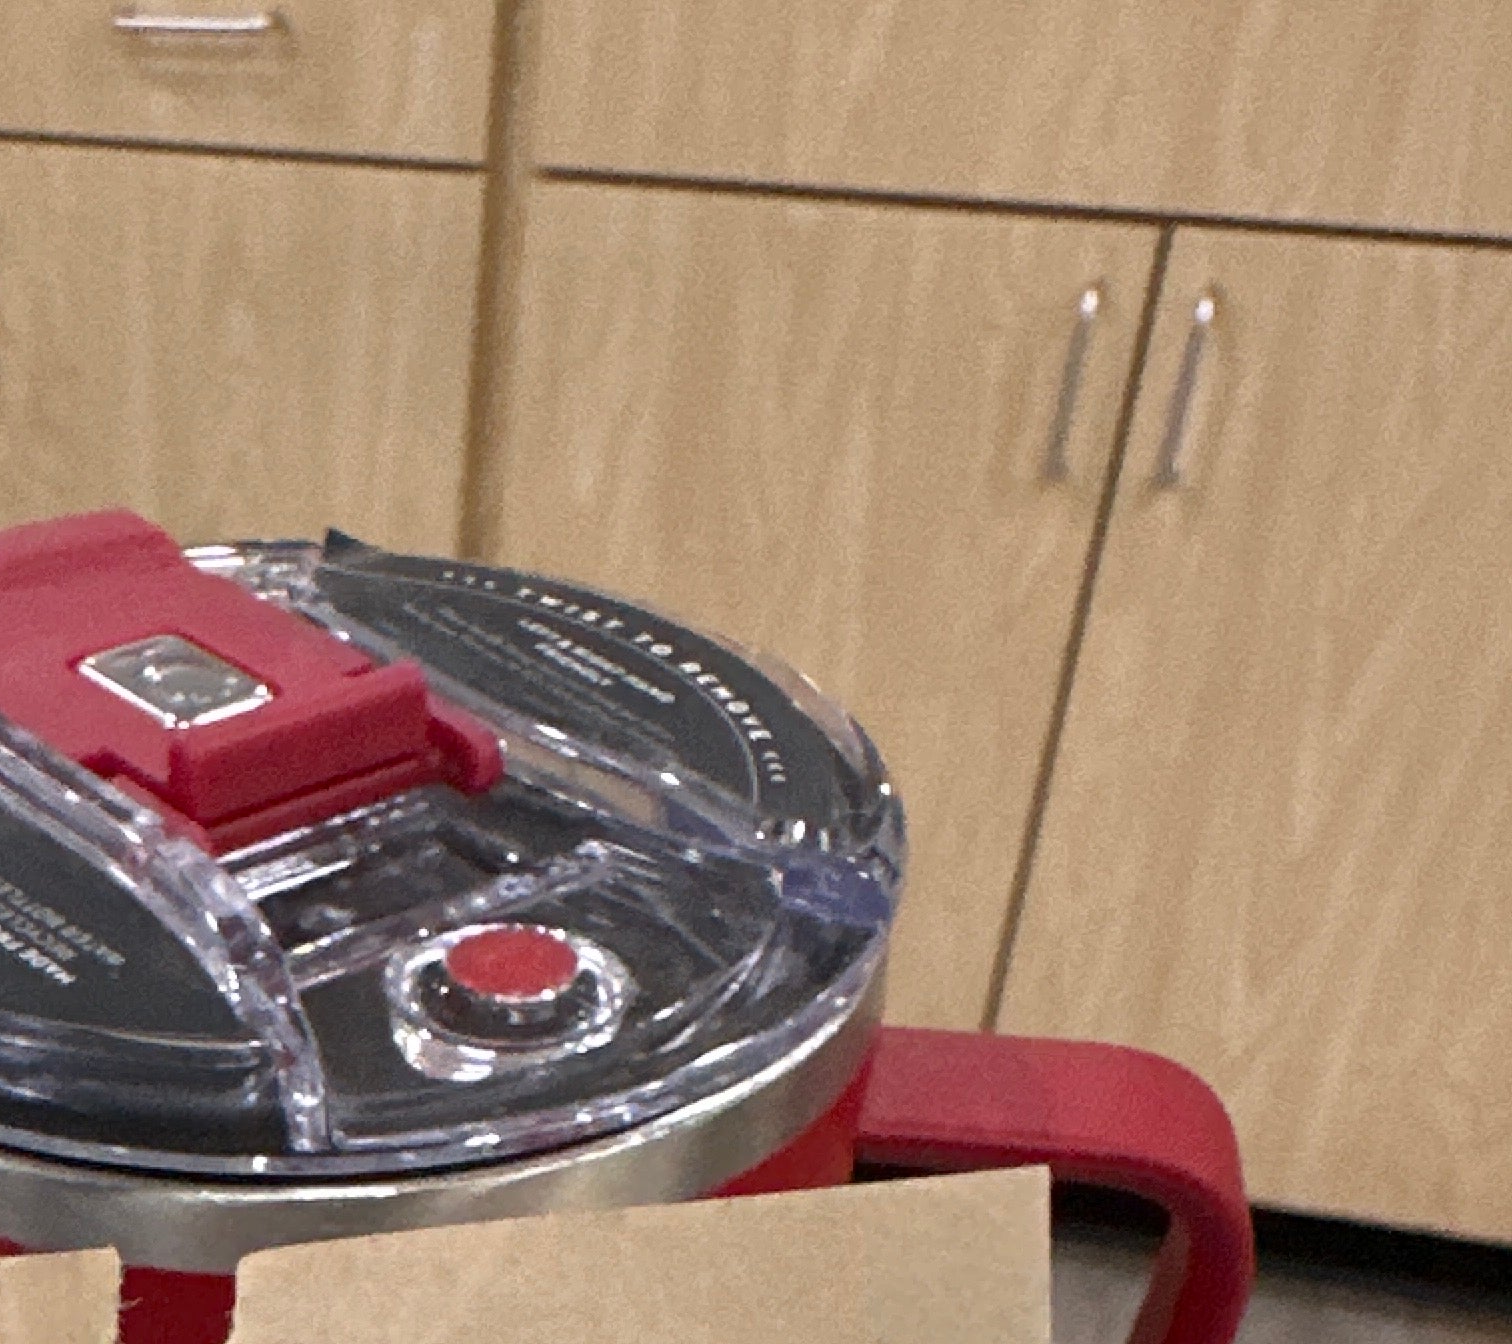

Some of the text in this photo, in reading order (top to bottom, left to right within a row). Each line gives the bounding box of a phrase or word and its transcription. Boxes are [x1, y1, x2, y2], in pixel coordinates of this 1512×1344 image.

[516, 586, 625, 632] TWIST
[633, 630, 675, 658] TO
[678, 659, 774, 742] REMOVE
